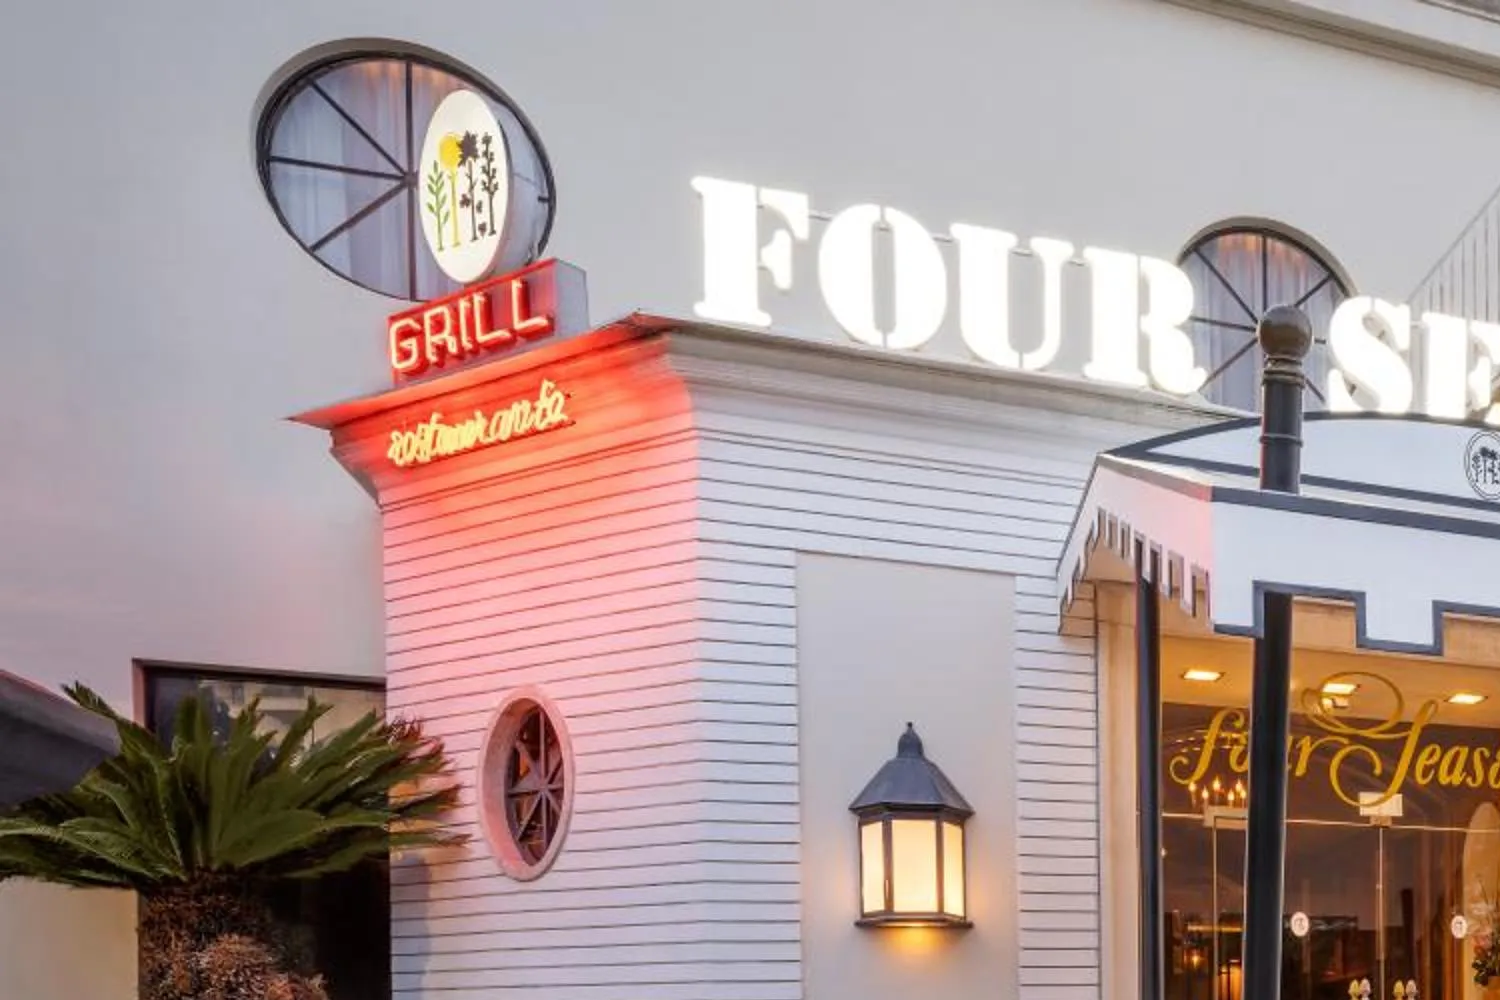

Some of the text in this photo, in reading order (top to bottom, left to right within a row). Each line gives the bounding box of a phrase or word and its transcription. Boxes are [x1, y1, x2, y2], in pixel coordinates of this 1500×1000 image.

[390, 279, 549, 369] GRILL
[690, 175, 1208, 396] FOUR
[1169, 707, 1350, 785] For
